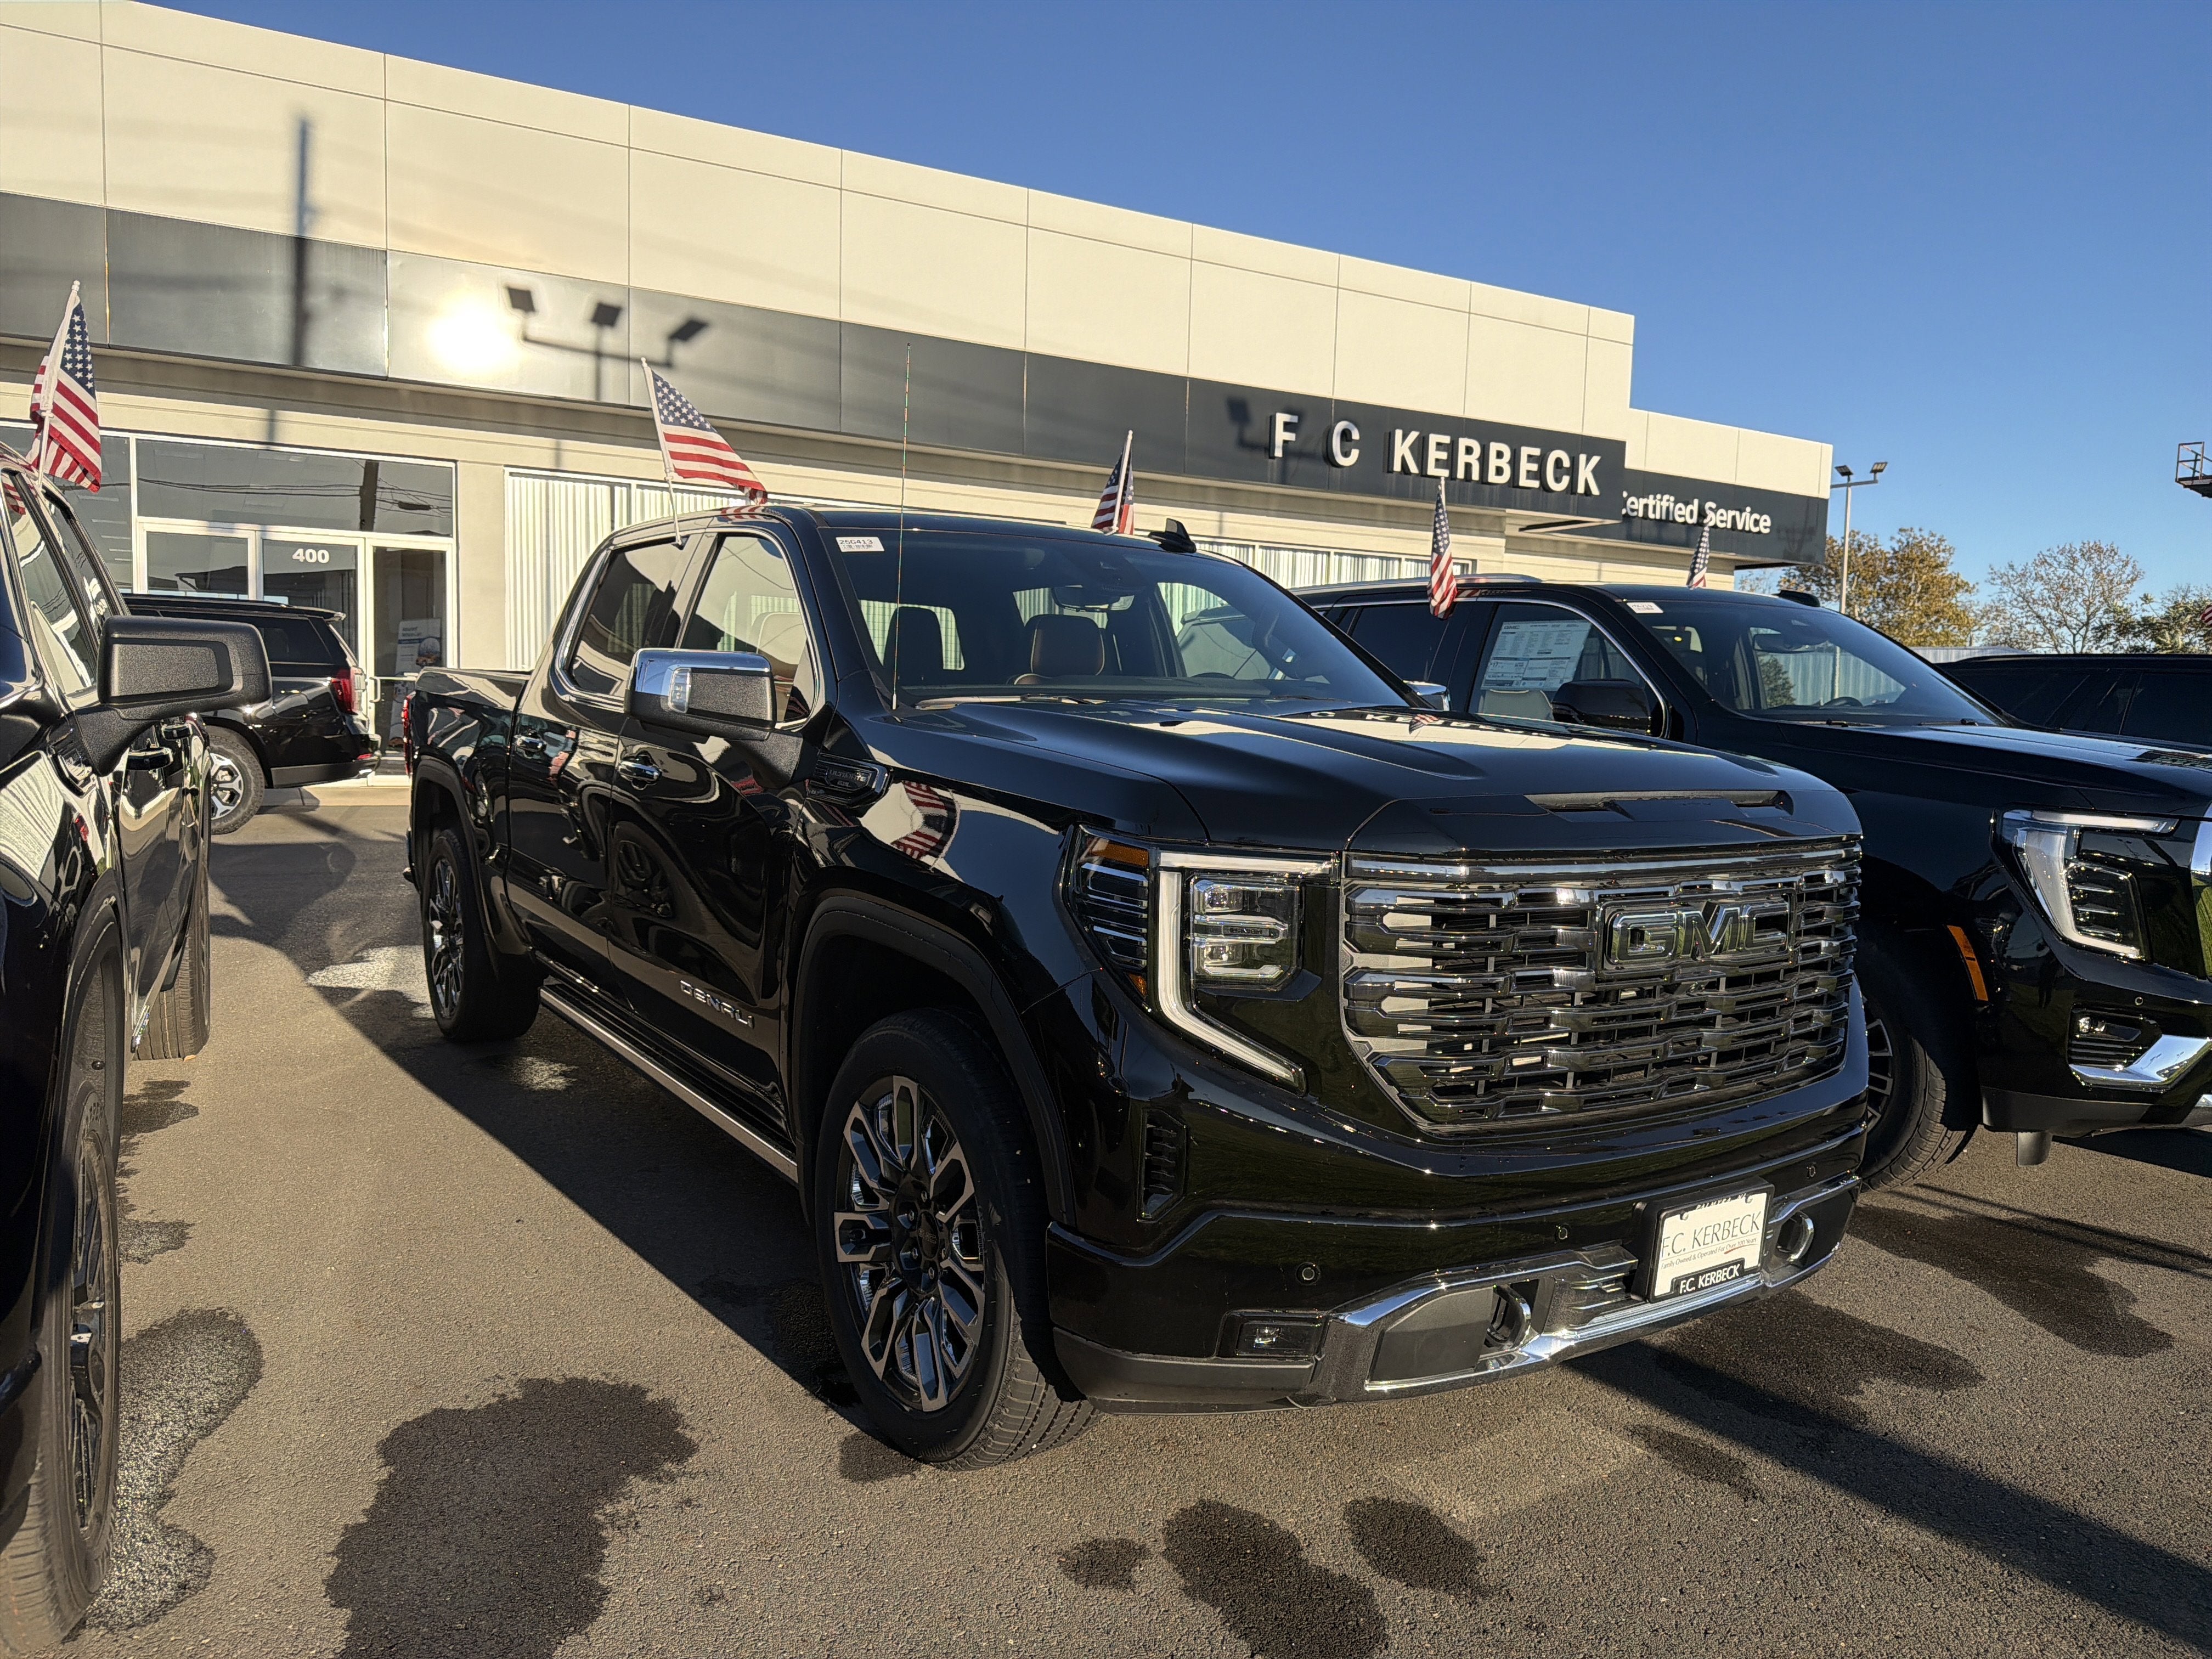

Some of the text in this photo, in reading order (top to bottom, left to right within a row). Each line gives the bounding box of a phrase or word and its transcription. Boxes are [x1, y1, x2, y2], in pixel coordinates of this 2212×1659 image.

[1274, 412, 1601, 495] F C KERBECK
[1622, 490, 1772, 534] ertified Service
[292, 548, 330, 563] 400
[1612, 901, 1790, 962] GMC
[680, 980, 754, 1029] DENALI
[1661, 1211, 1762, 1258] F.C. KERBECK
[1675, 1255, 1692, 1265] Owned
[1697, 1247, 1718, 1259] Operated
[1679, 1263, 1741, 1294] F.C. KERBECK
